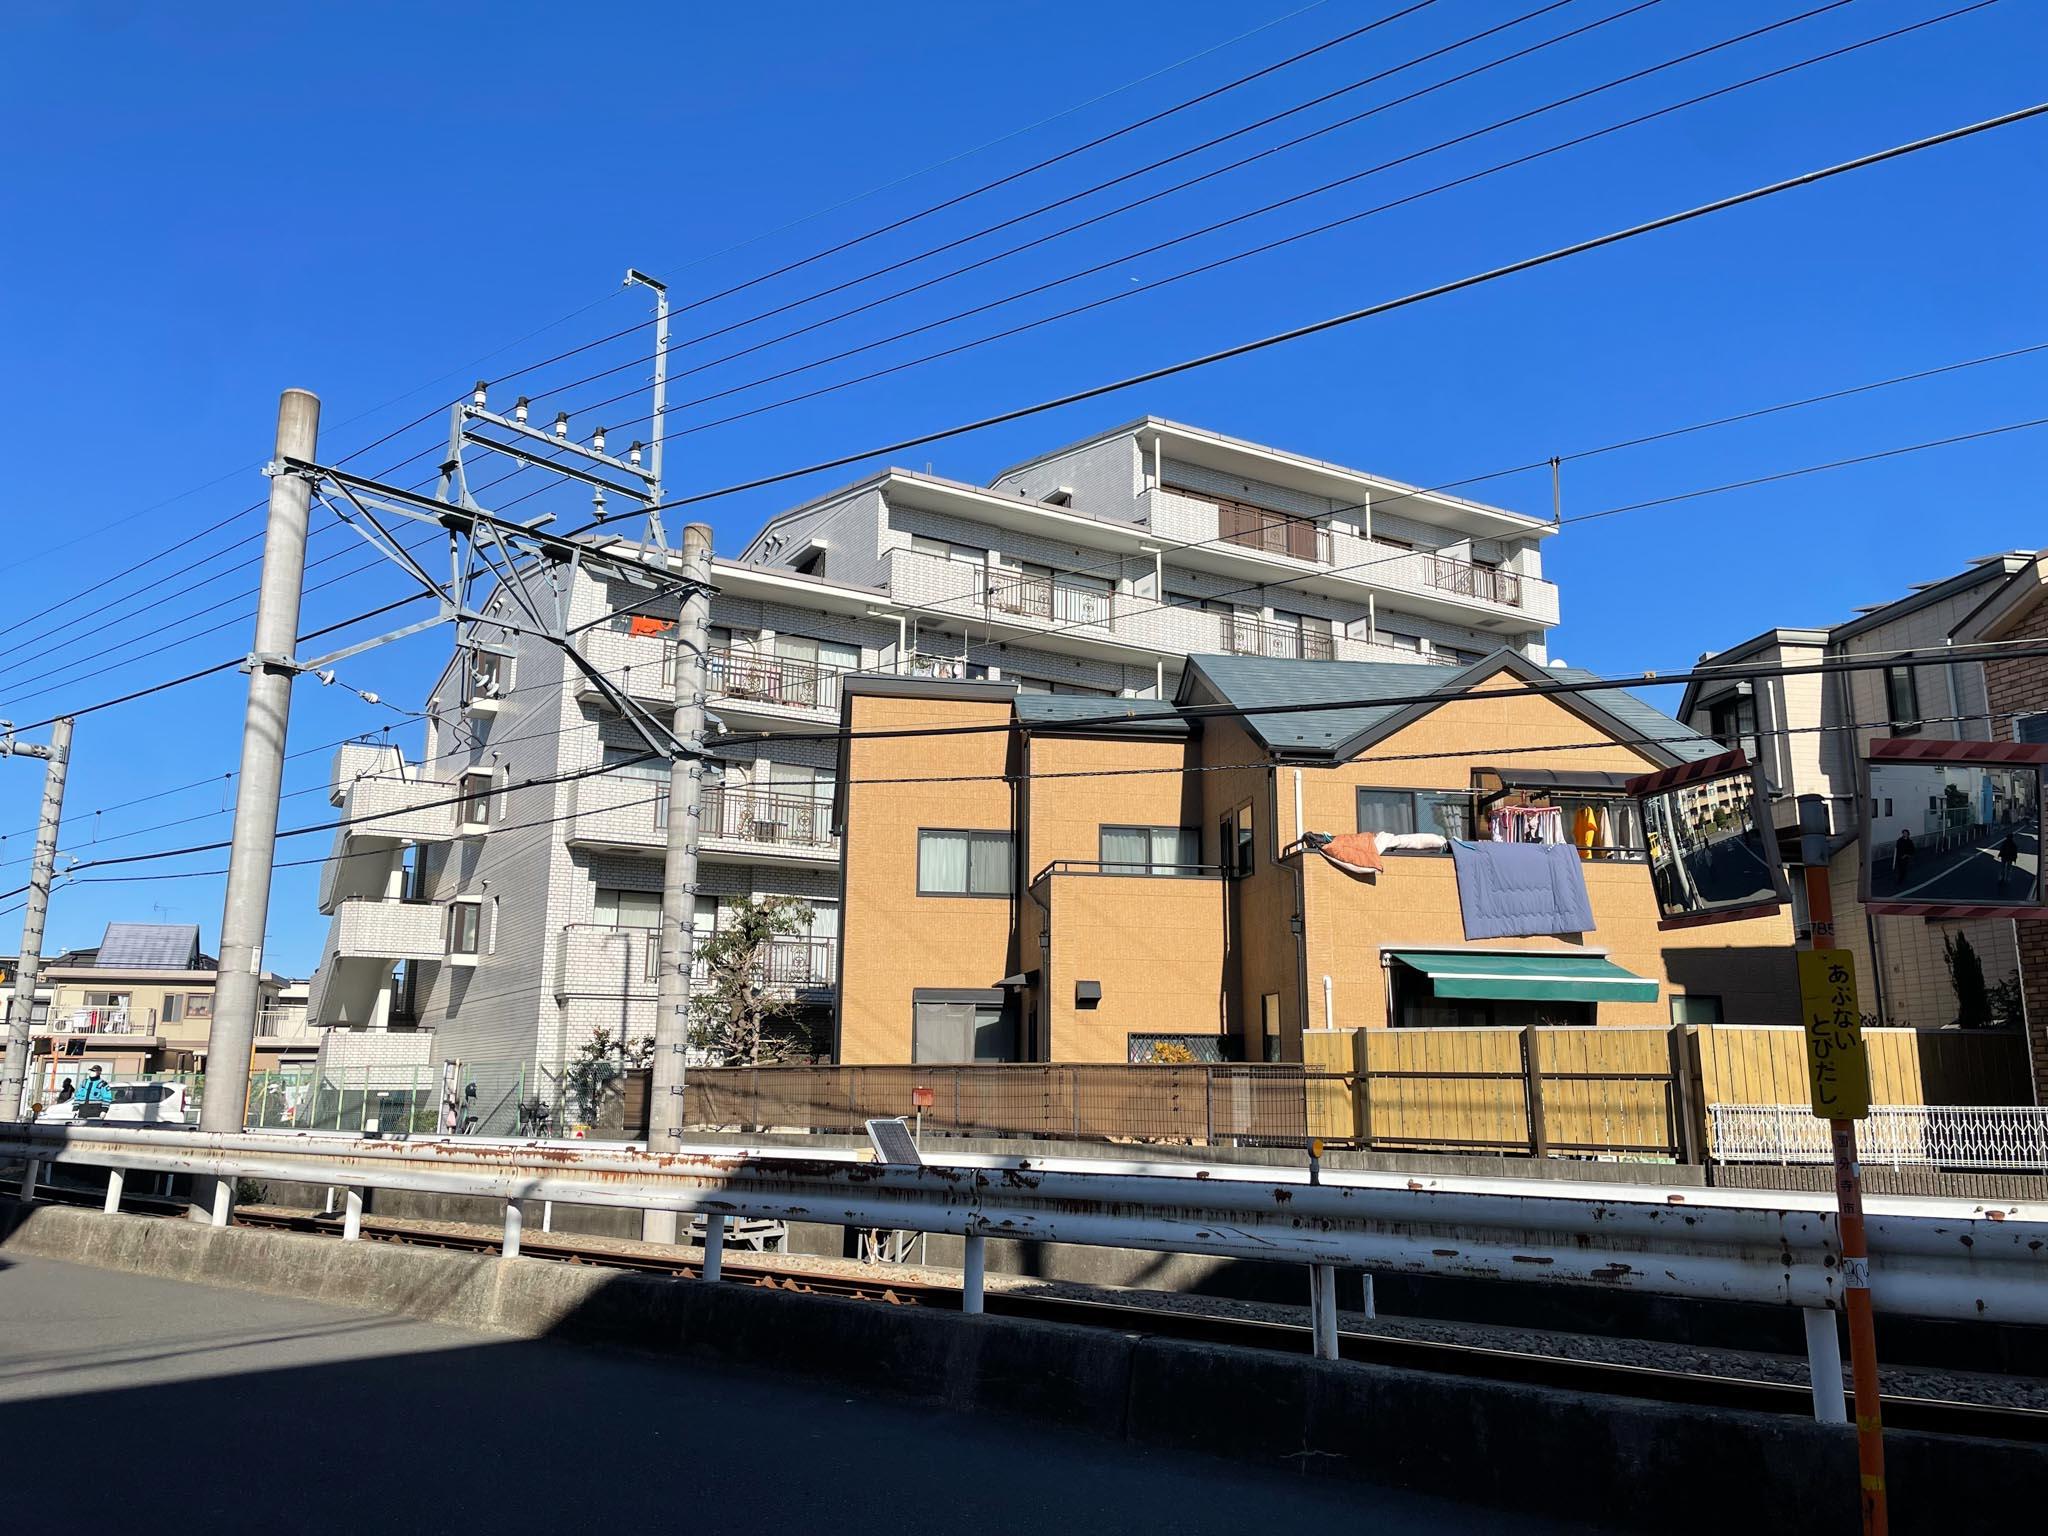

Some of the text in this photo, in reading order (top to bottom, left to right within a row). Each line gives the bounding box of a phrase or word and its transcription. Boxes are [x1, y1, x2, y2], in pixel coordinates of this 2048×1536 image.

[1828, 964, 1856, 1050] あぶない
[1812, 1013, 1837, 1104] とびだし
